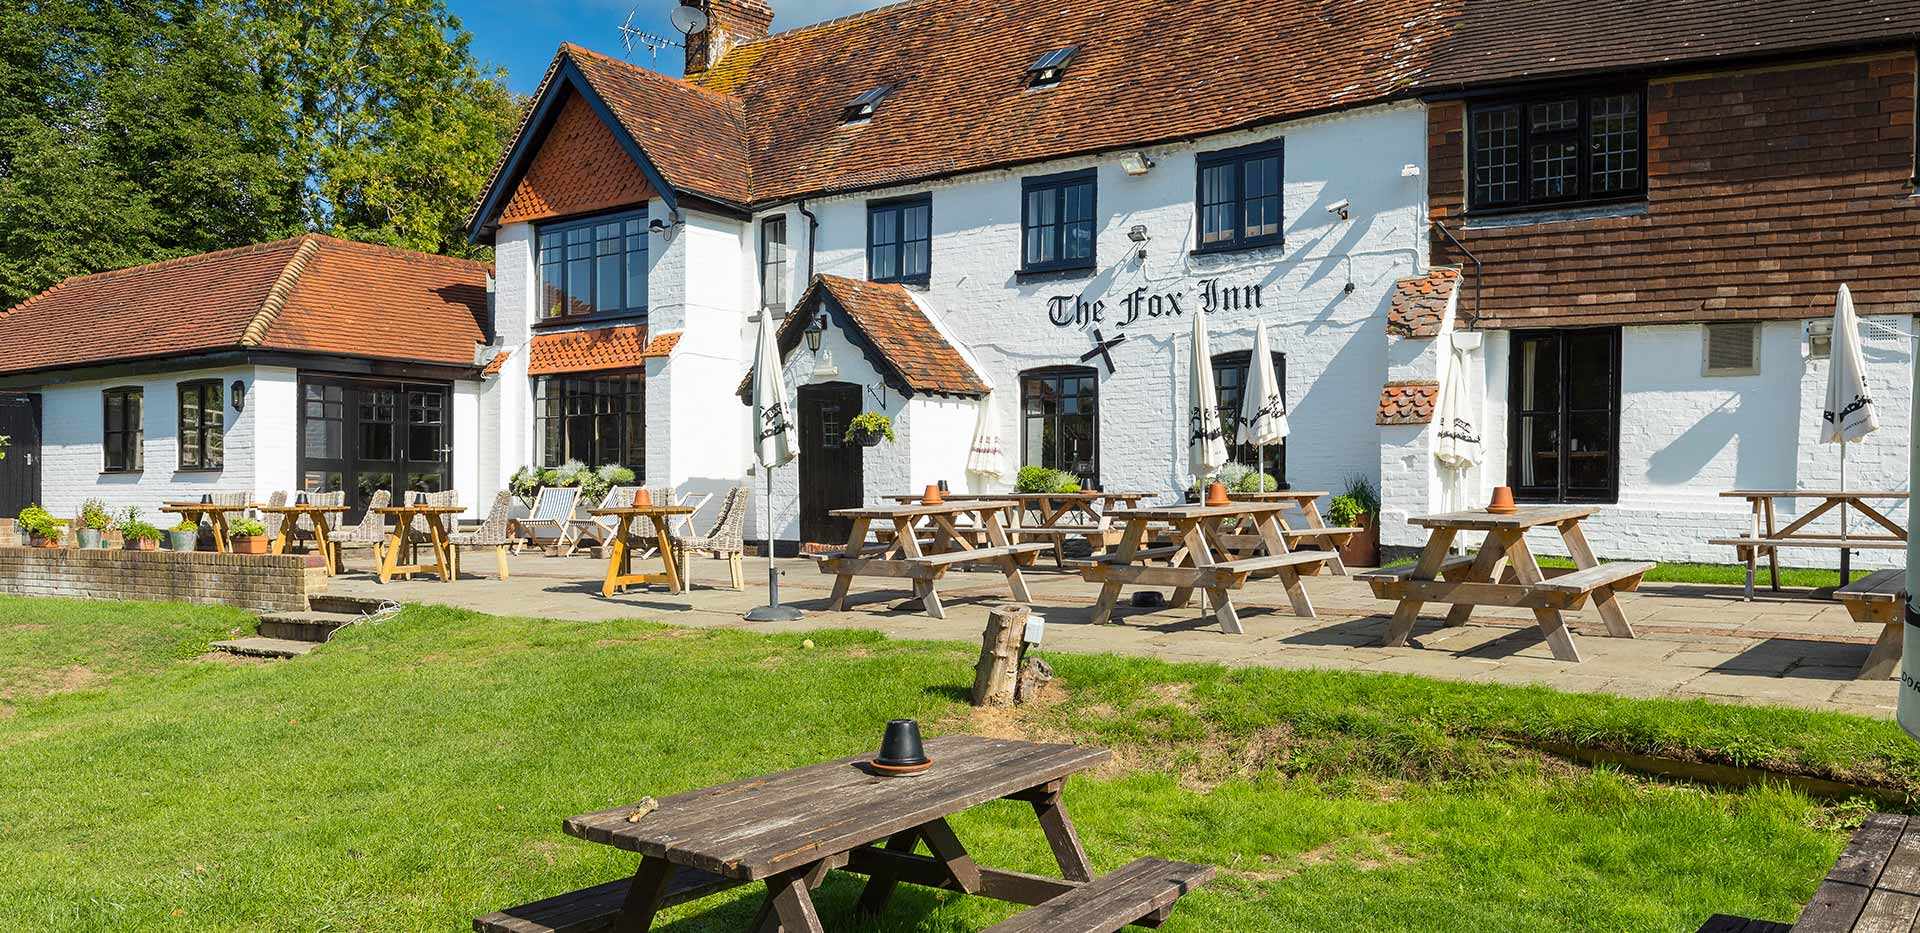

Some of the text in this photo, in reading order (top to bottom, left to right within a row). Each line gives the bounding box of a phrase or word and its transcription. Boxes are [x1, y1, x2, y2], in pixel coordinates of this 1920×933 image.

[1047, 277, 1263, 332] The Fox Inn
